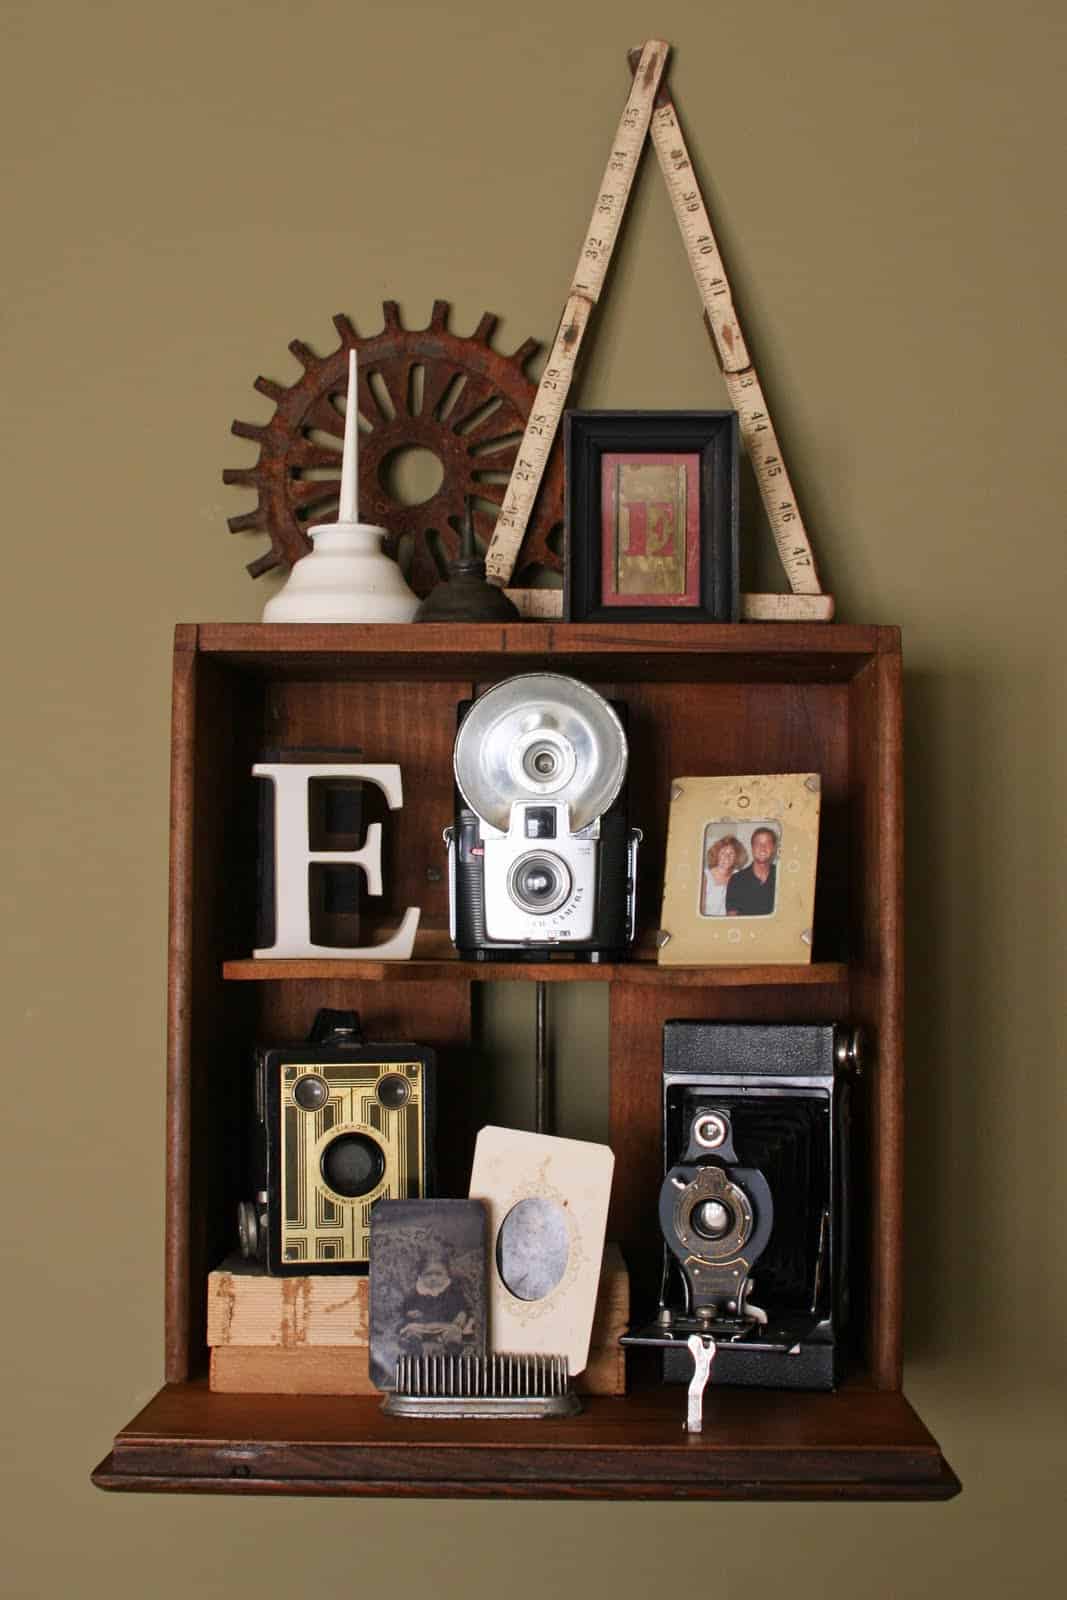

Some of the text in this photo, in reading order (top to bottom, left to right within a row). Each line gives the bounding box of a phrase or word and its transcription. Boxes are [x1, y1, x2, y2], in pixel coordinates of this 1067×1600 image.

[657, 108, 674, 128] 37
[598, 194, 615, 214] 33
[683, 191, 700, 213] 39
[585, 237, 603, 260] 32
[697, 235, 713, 255] 40
[710, 278, 726, 296] 41
[543, 368, 561, 391] 29
[529, 415, 546, 436] 28
[751, 410, 768, 433] 44
[515, 458, 533, 481] 27
[764, 454, 782, 478] 45
[779, 501, 796, 523] 46
[622, 501, 675, 558] E
[792, 546, 811, 567] 47
[251, 763, 421, 960] E
